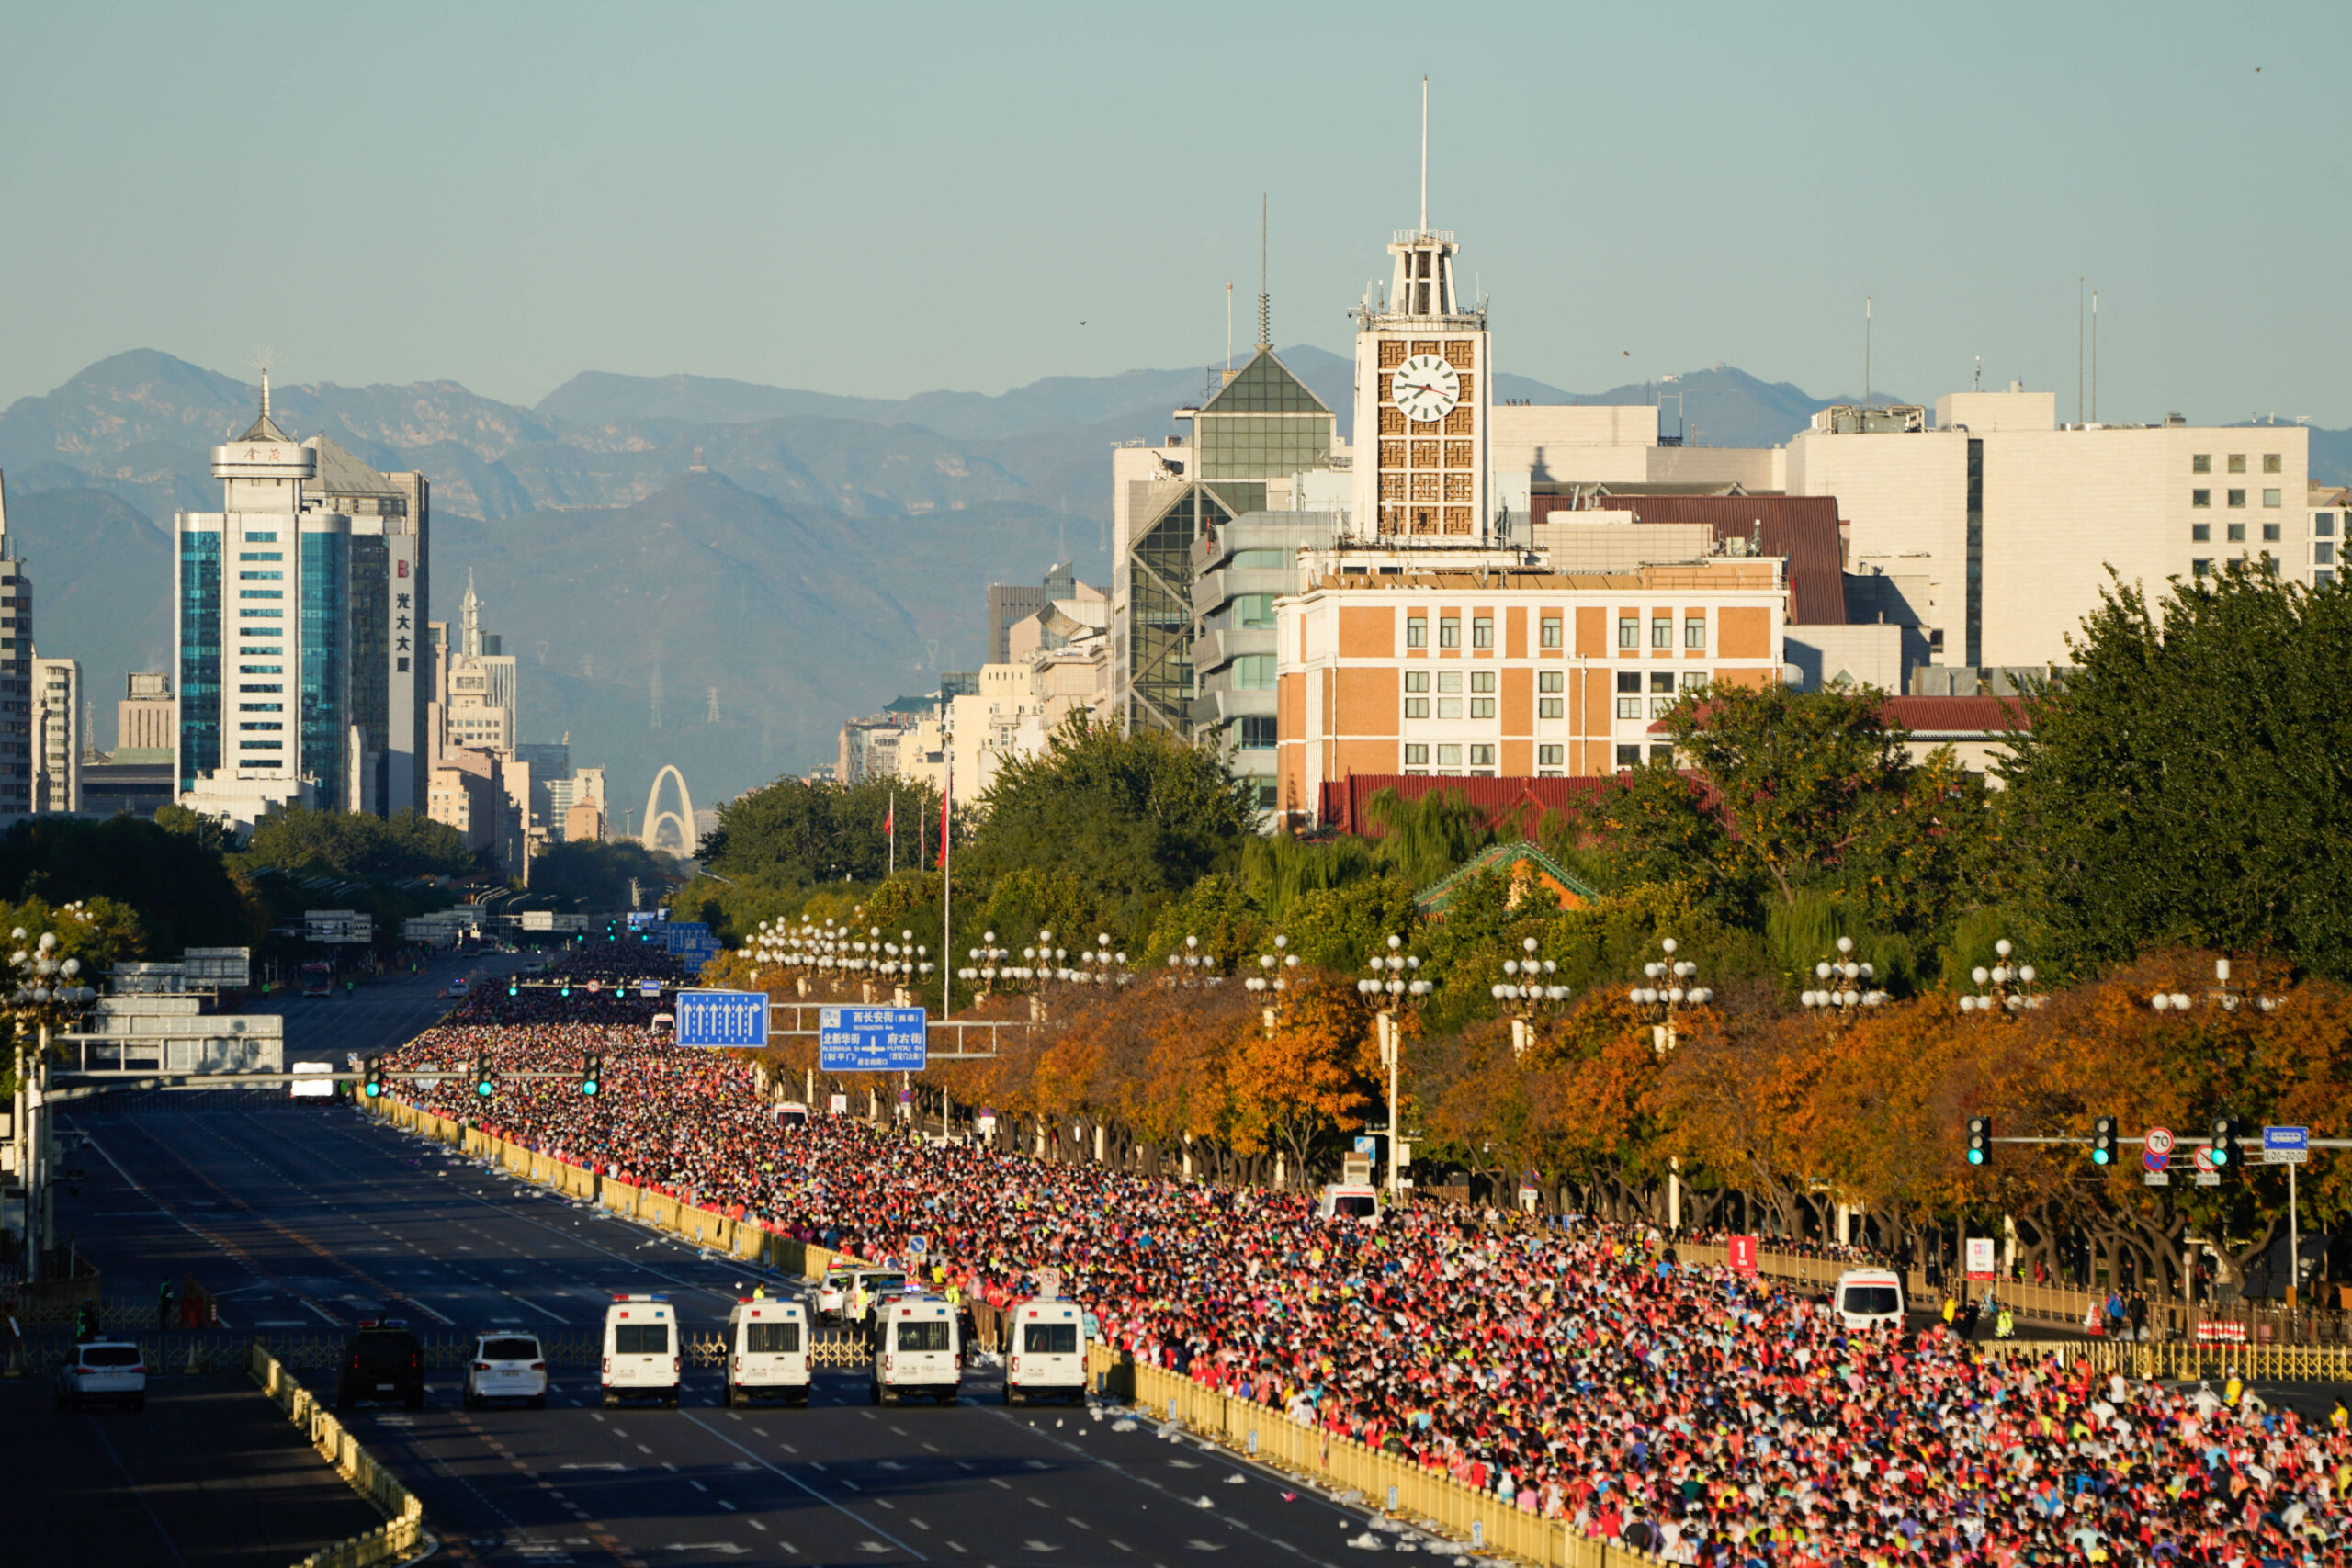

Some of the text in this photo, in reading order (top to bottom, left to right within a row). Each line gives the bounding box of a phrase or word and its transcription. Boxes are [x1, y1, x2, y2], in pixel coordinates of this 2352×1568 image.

[396, 592, 411, 672] 光大大厦
[822, 1032, 861, 1045] 北新华街
[888, 1032, 922, 1045] 府右街
[2153, 1135, 2169, 1147] 70
[1738, 1240, 1746, 1258] 1
